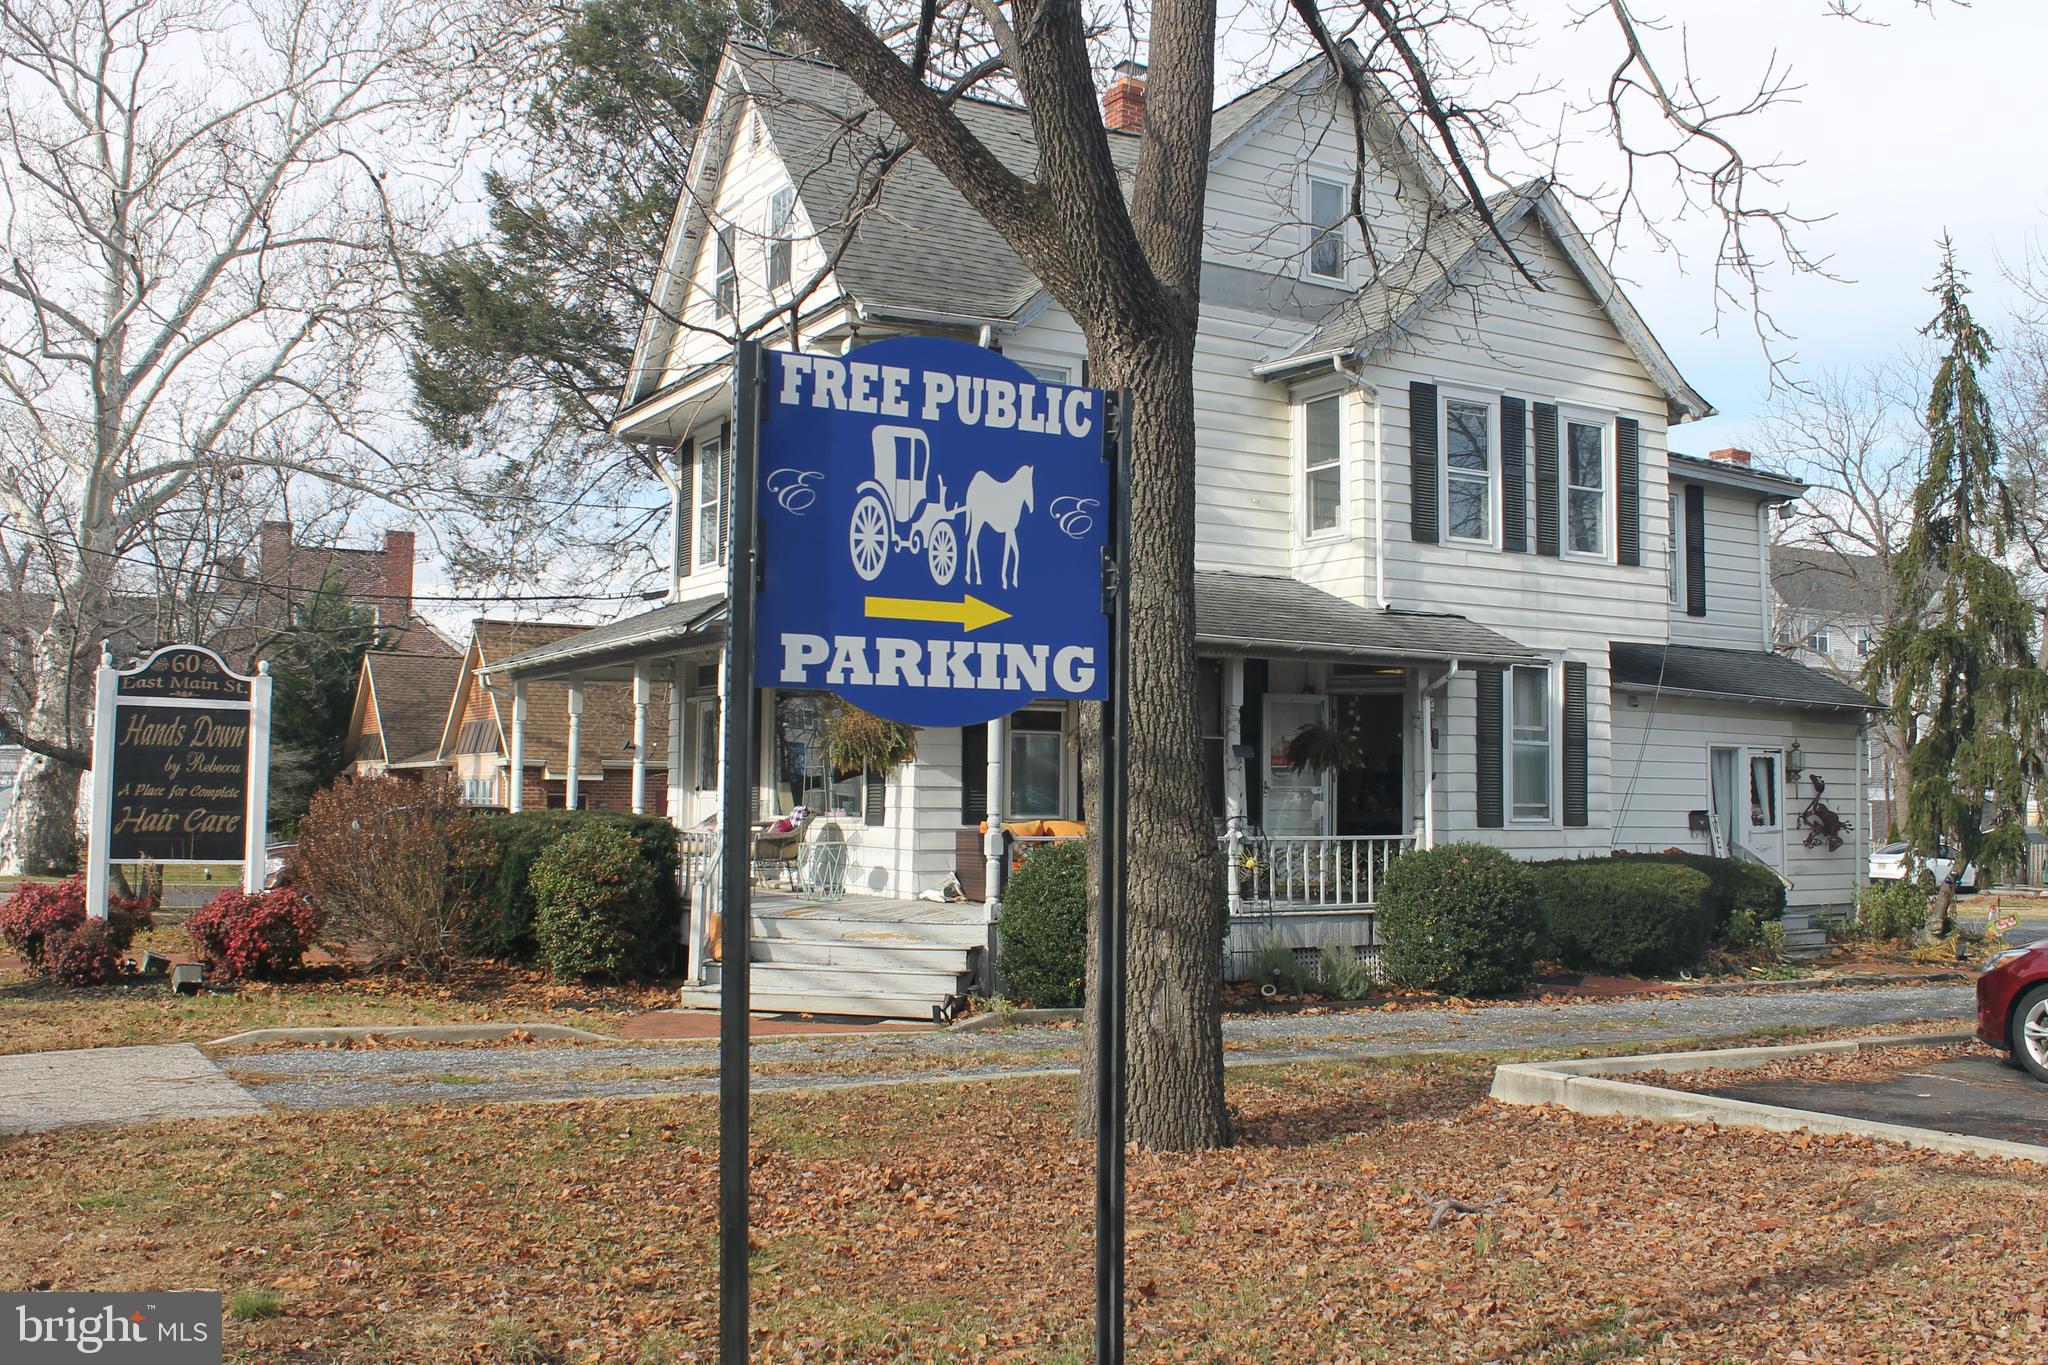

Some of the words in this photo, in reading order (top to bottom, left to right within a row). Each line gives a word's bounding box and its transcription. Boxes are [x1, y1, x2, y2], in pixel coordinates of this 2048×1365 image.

[779, 353, 911, 418] FREE
[921, 370, 1093, 438] PUBLIC
[171, 654, 199, 673] 60
[779, 632, 1096, 693] PARKING
[122, 676, 165, 690] East
[168, 675, 220, 691] Main
[223, 679, 249, 694] St.
[119, 713, 187, 747] Hands
[189, 714, 247, 748] Down
[164, 754, 181, 780] by
[186, 751, 241, 774] Rebecca
[117, 783, 129, 797] A
[134, 783, 165, 797] Place
[168, 784, 187, 800] for
[190, 784, 241, 800] Complete
[113, 805, 179, 834] Hair
[183, 807, 241, 833] Care
